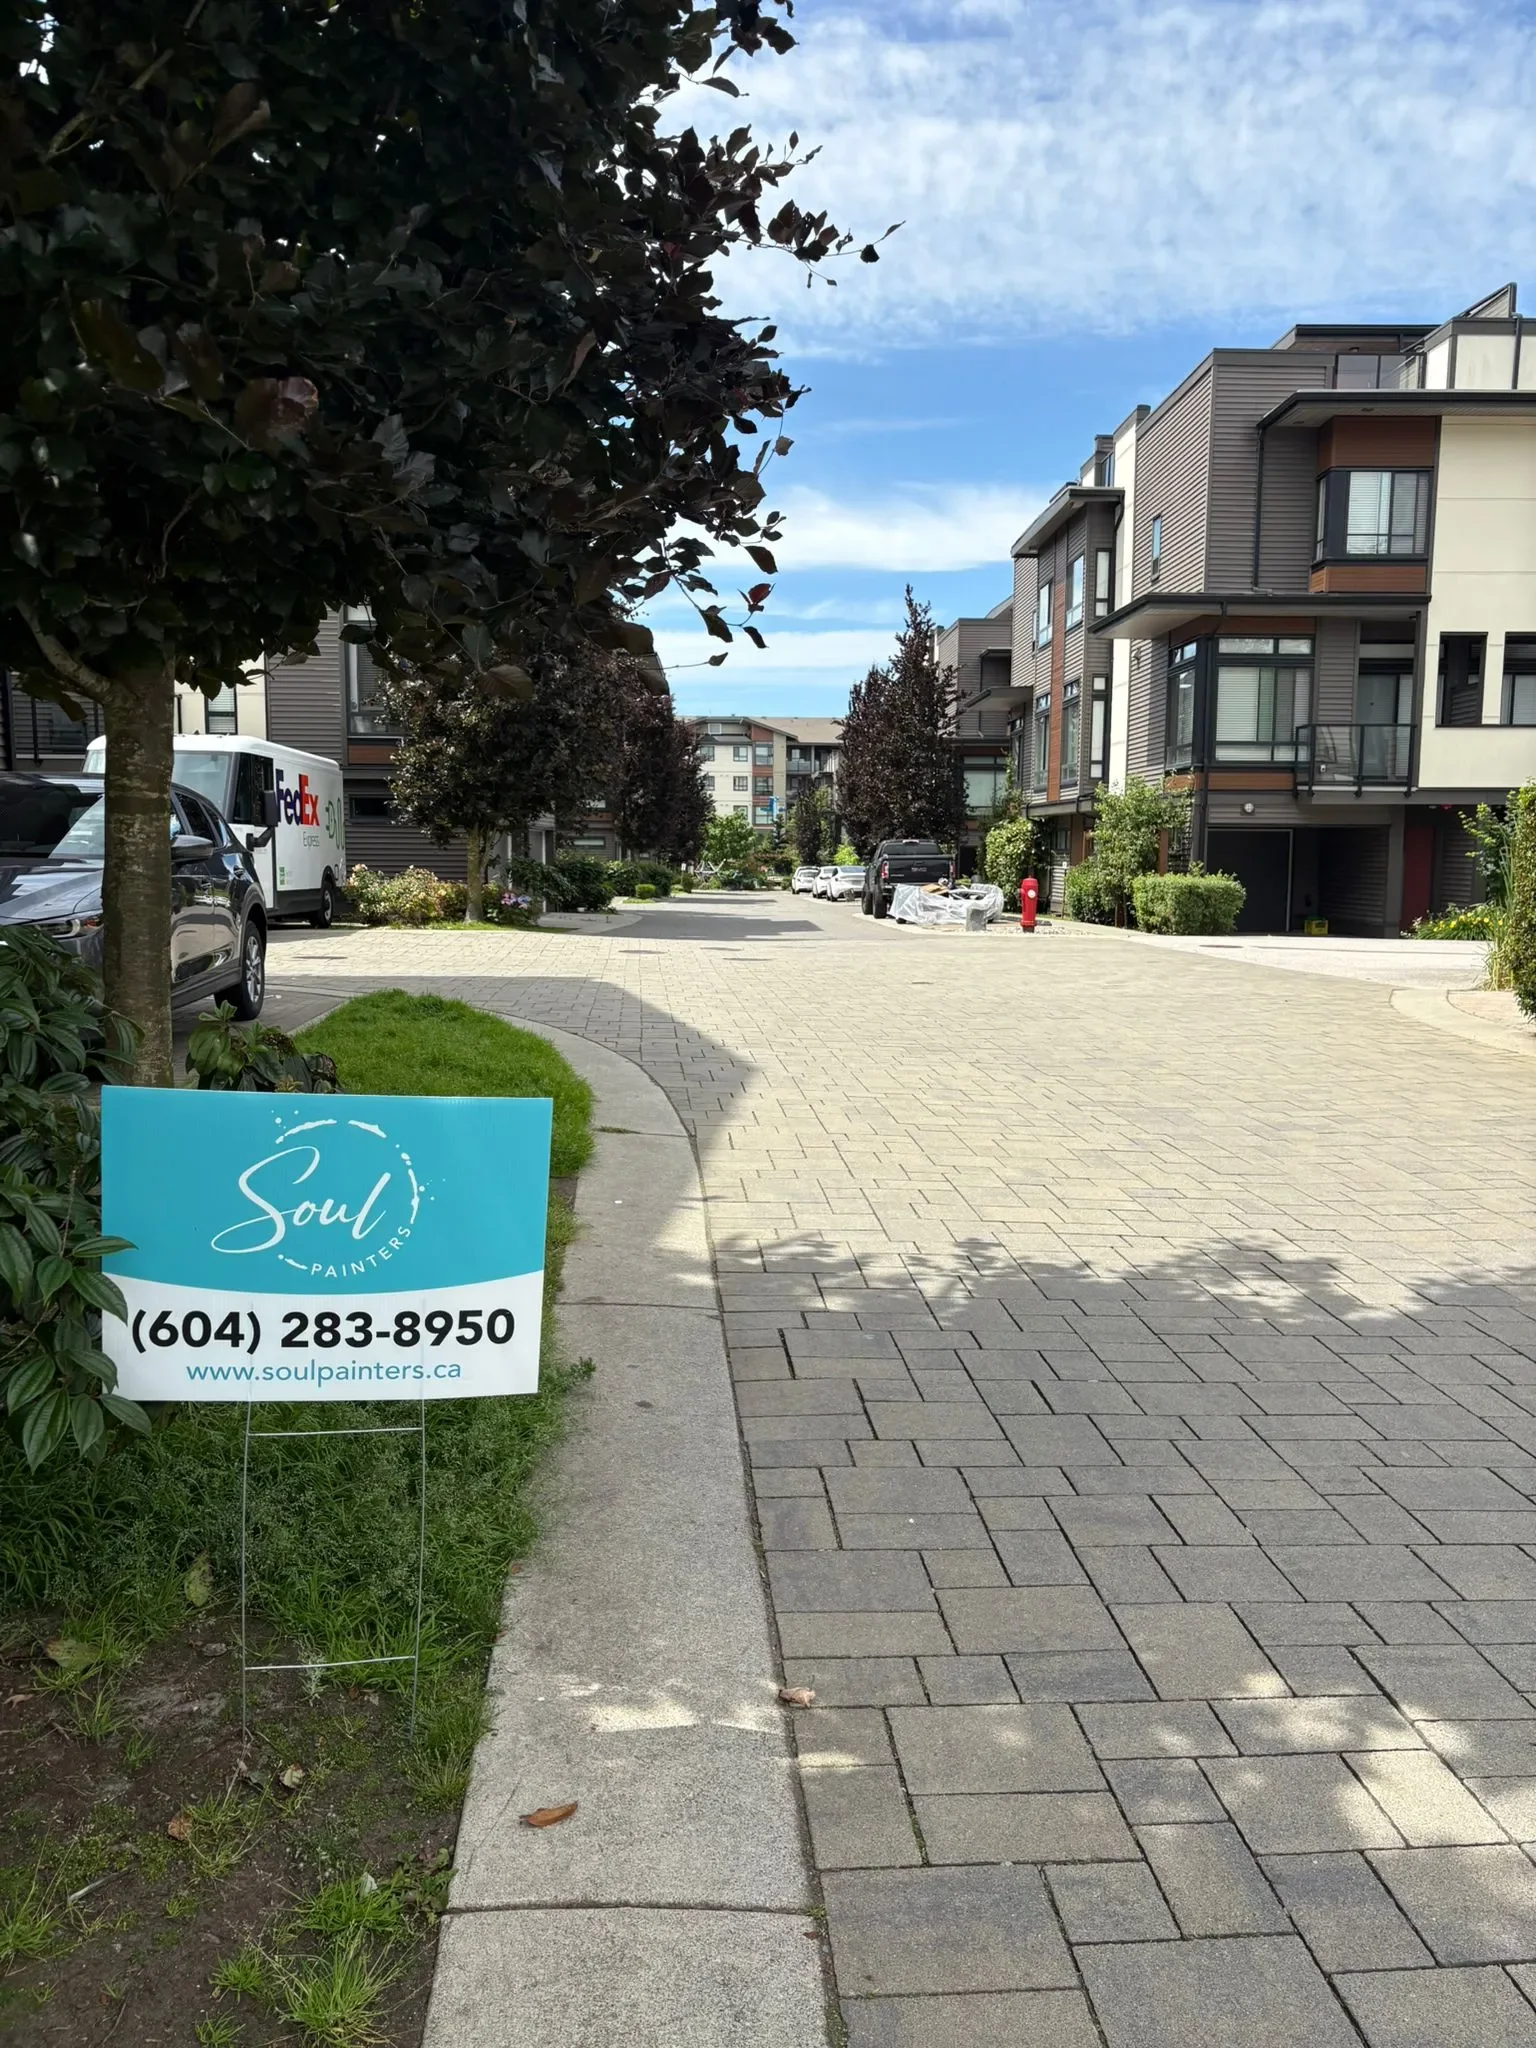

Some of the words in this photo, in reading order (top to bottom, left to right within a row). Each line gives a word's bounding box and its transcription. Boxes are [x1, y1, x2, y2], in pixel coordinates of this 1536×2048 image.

[276, 769, 320, 826] FedEx
[210, 1145, 392, 1254] Soul
[311, 1225, 411, 1278] PAINTERS
[131, 1309, 261, 1354] (604)
[280, 1308, 515, 1348] 283-8950
[186, 1359, 462, 1387] www.soulpainters.ca
